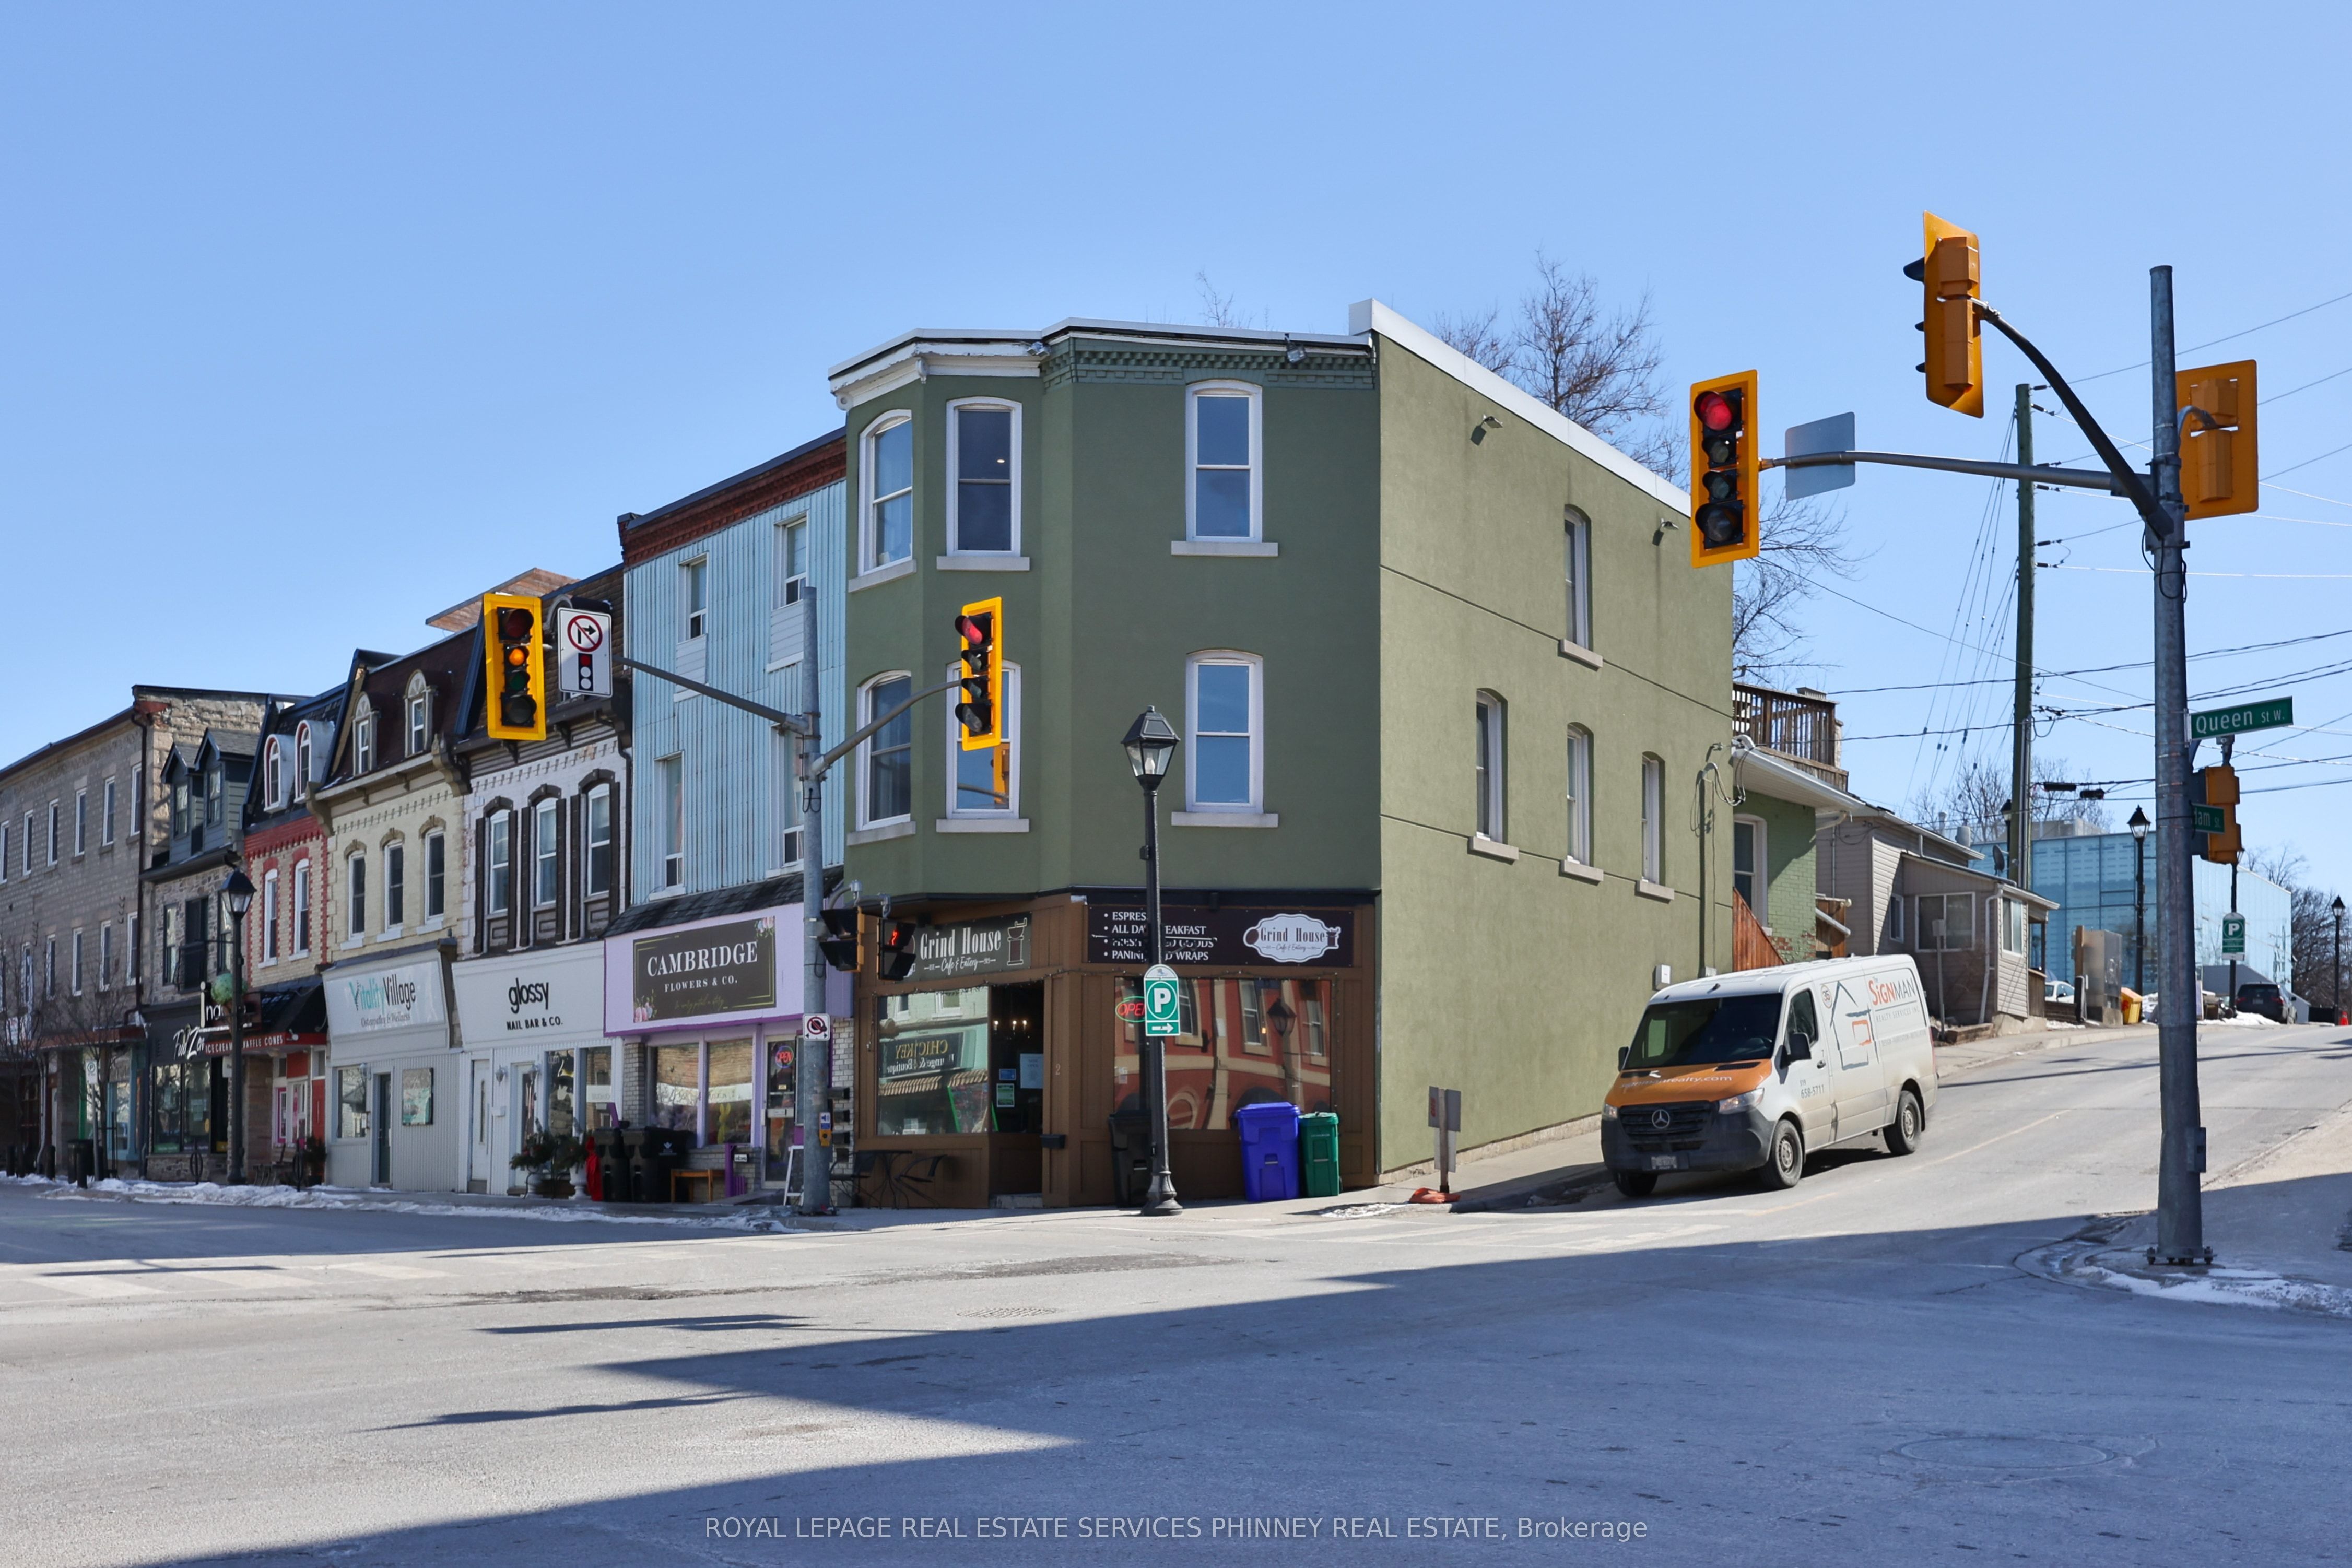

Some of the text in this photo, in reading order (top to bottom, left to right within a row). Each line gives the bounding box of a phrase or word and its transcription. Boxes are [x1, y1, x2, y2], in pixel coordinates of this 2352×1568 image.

[2196, 711, 2253, 734] Queen
[2261, 711, 2270, 723] St
[1112, 924, 1207, 935] ALL DA EAKFAST
[1260, 926, 1325, 942] Grind House
[2228, 923, 2240, 936] P
[920, 927, 1002, 960] Grind House
[647, 941, 758, 977] CAMBRIDGE
[960, 956, 979, 971] Eatery
[1175, 951, 1209, 961] WRAPS
[664, 975, 738, 993] FLOWERS & CO.
[349, 974, 416, 1015] Vitality Village
[508, 977, 549, 1015] glossy
[1154, 988, 1171, 1013] P
[391, 1012, 411, 1022] Wellness
[1875, 1013, 1891, 1023] REALTY
[1892, 1007, 1912, 1019] SERVICES
[506, 1016, 563, 1031] NAIL BAR & CO.
[205, 1044, 215, 1054] ICE
[264, 1034, 283, 1046] CONES
[776, 1051, 793, 1063] OPEN
[1055, 1063, 1061, 1076] 2
[1801, 1084, 1825, 1099] 658-5711
